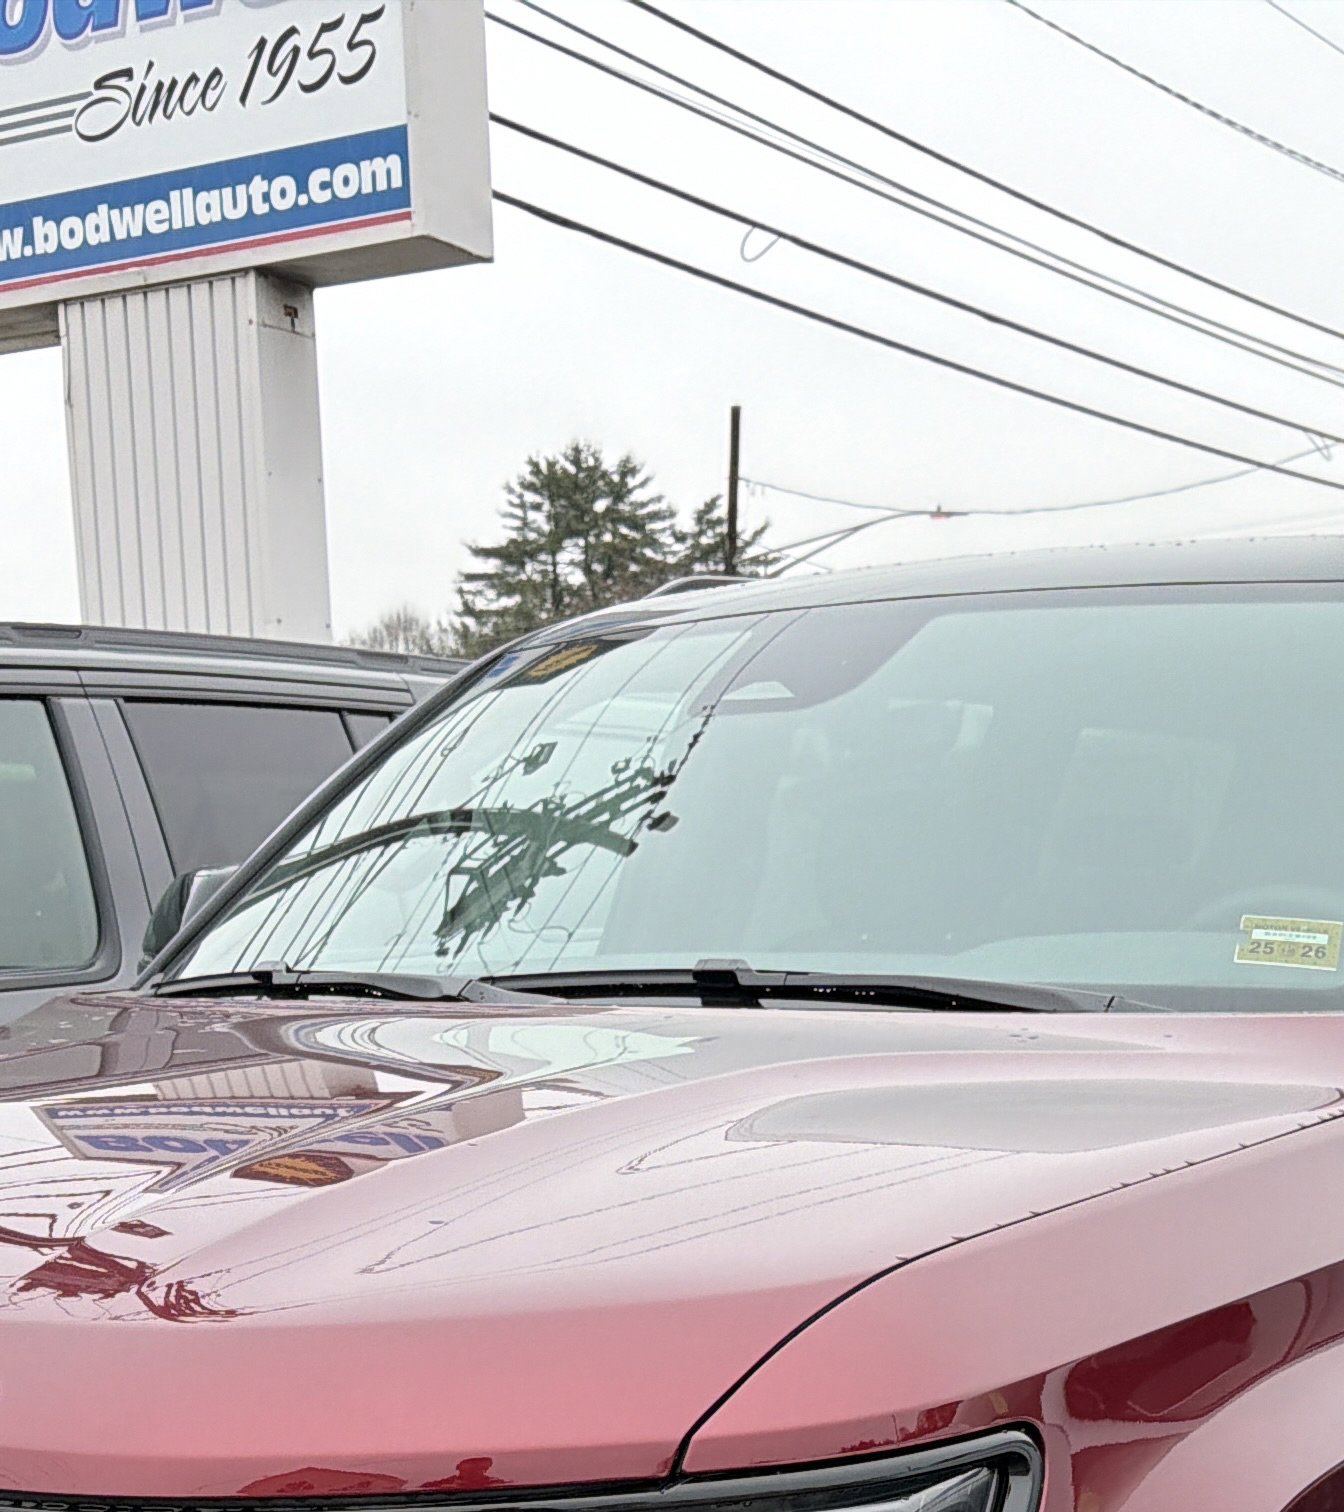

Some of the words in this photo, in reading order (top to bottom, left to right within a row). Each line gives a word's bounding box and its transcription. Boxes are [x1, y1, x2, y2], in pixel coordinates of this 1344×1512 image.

[74, 59, 228, 142] Since
[238, 4, 386, 108] 1955
[1249, 941, 1275, 955] 25
[1300, 945, 1327, 959] 26
